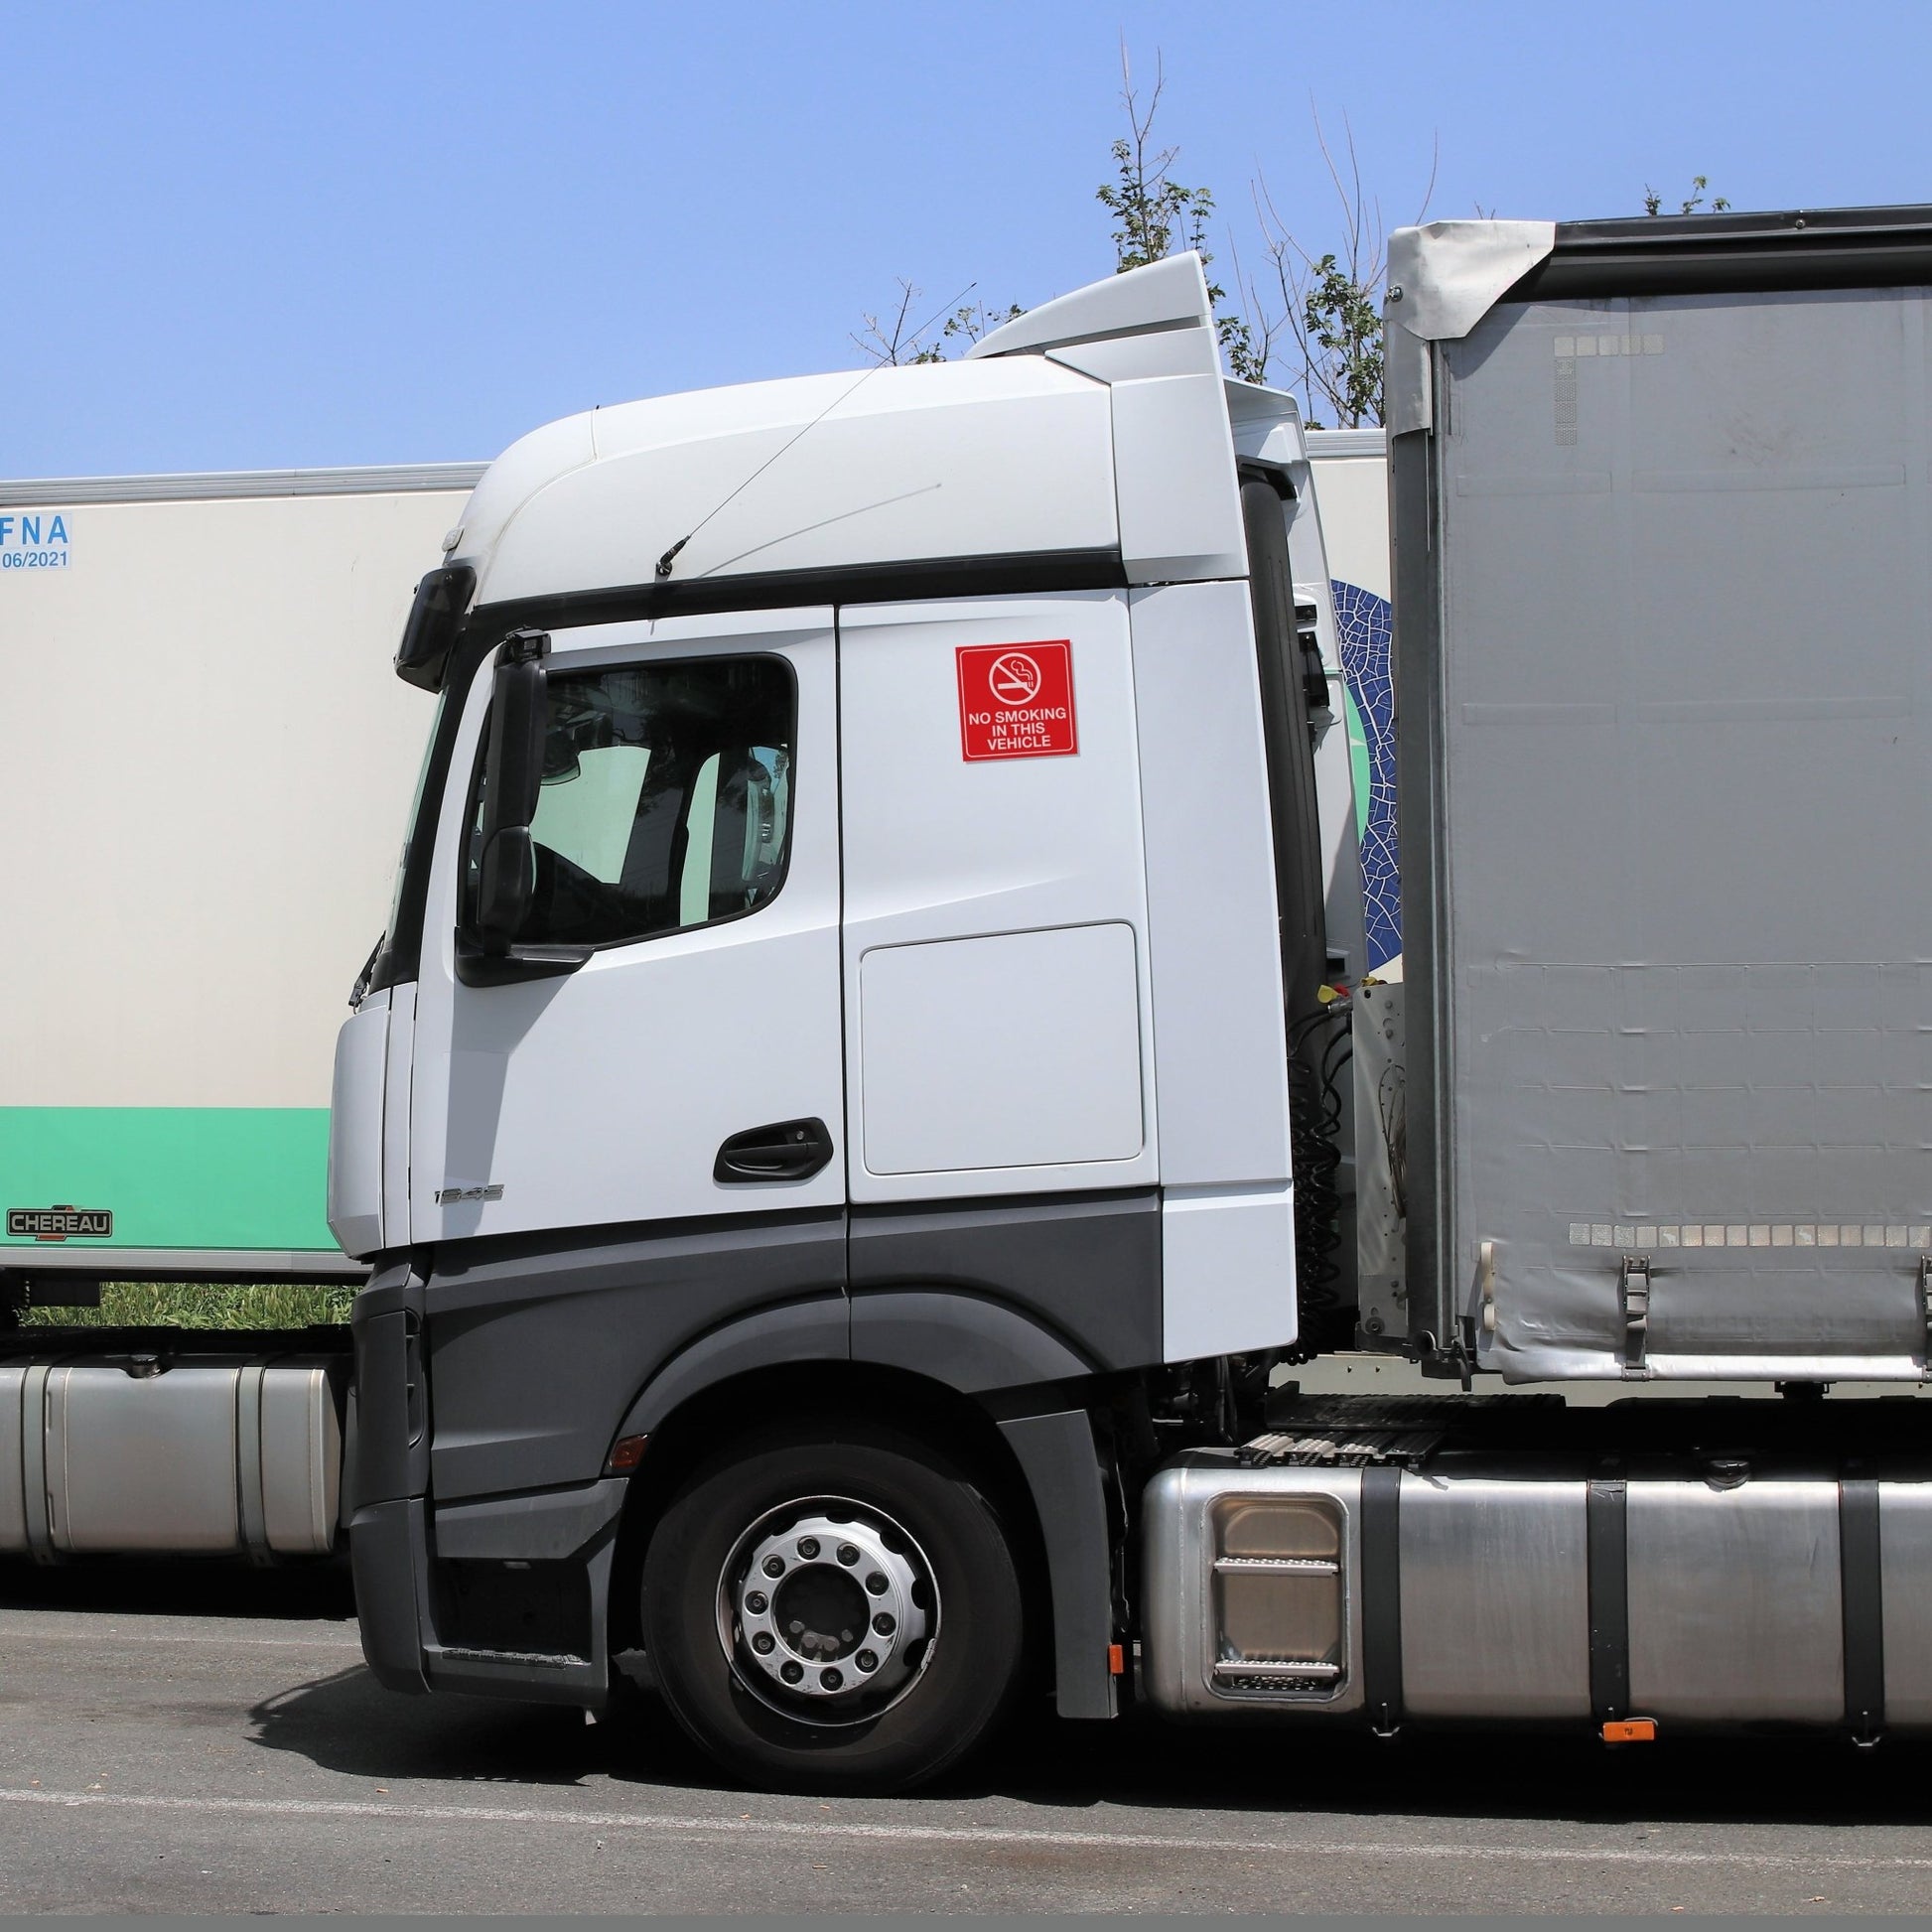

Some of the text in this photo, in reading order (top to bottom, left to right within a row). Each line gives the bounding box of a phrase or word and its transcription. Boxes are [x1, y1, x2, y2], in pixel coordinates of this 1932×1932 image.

[0, 515, 69, 545] FNA
[2, 551, 67, 568] 06/2021
[969, 707, 1066, 725] NO SMOKING
[992, 722, 1045, 737] IN THIS
[987, 735, 1051, 751] VEHICLE
[11, 1214, 107, 1231] CHEREAU
